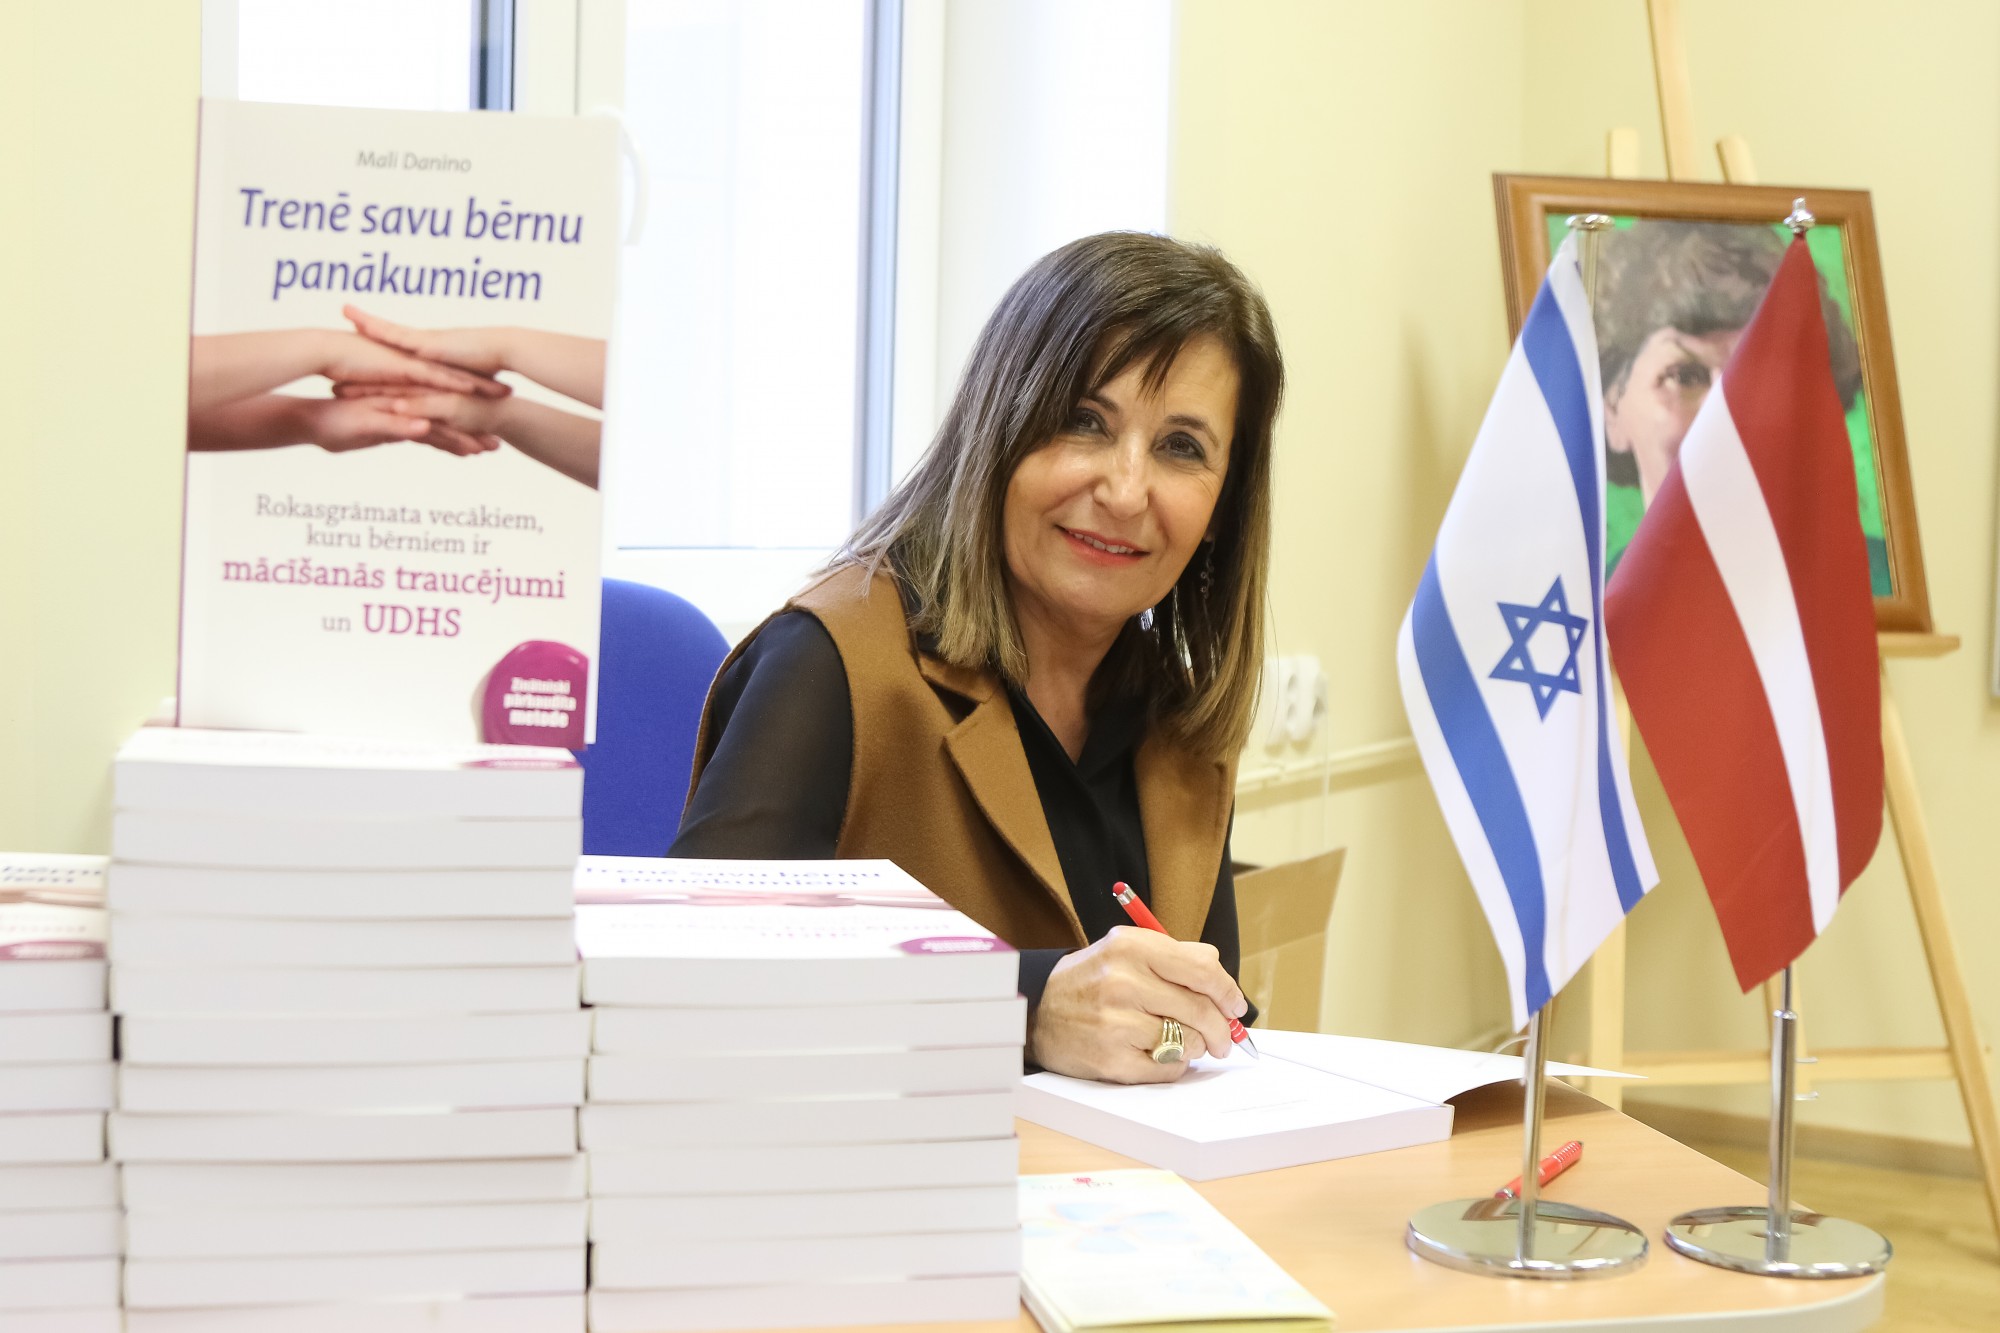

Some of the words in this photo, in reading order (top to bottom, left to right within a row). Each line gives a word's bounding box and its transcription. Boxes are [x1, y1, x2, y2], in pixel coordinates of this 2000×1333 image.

[356, 150, 398, 169] Mali
[403, 152, 472, 172] Danino
[239, 187, 351, 233] Trenē
[360, 202, 452, 239] savu
[464, 196, 584, 244] bērnu
[272, 251, 543, 301] panākumiem
[256, 493, 422, 526] Rokasgrāmata
[428, 504, 545, 534] vecākiem,
[306, 524, 361, 549] kuru
[368, 527, 466, 555] bērniem
[472, 536, 492, 556] ir
[222, 556, 385, 590] mācīšanās
[395, 564, 567, 604] traucējumi
[321, 613, 351, 633] un
[363, 603, 462, 638] UDHS
